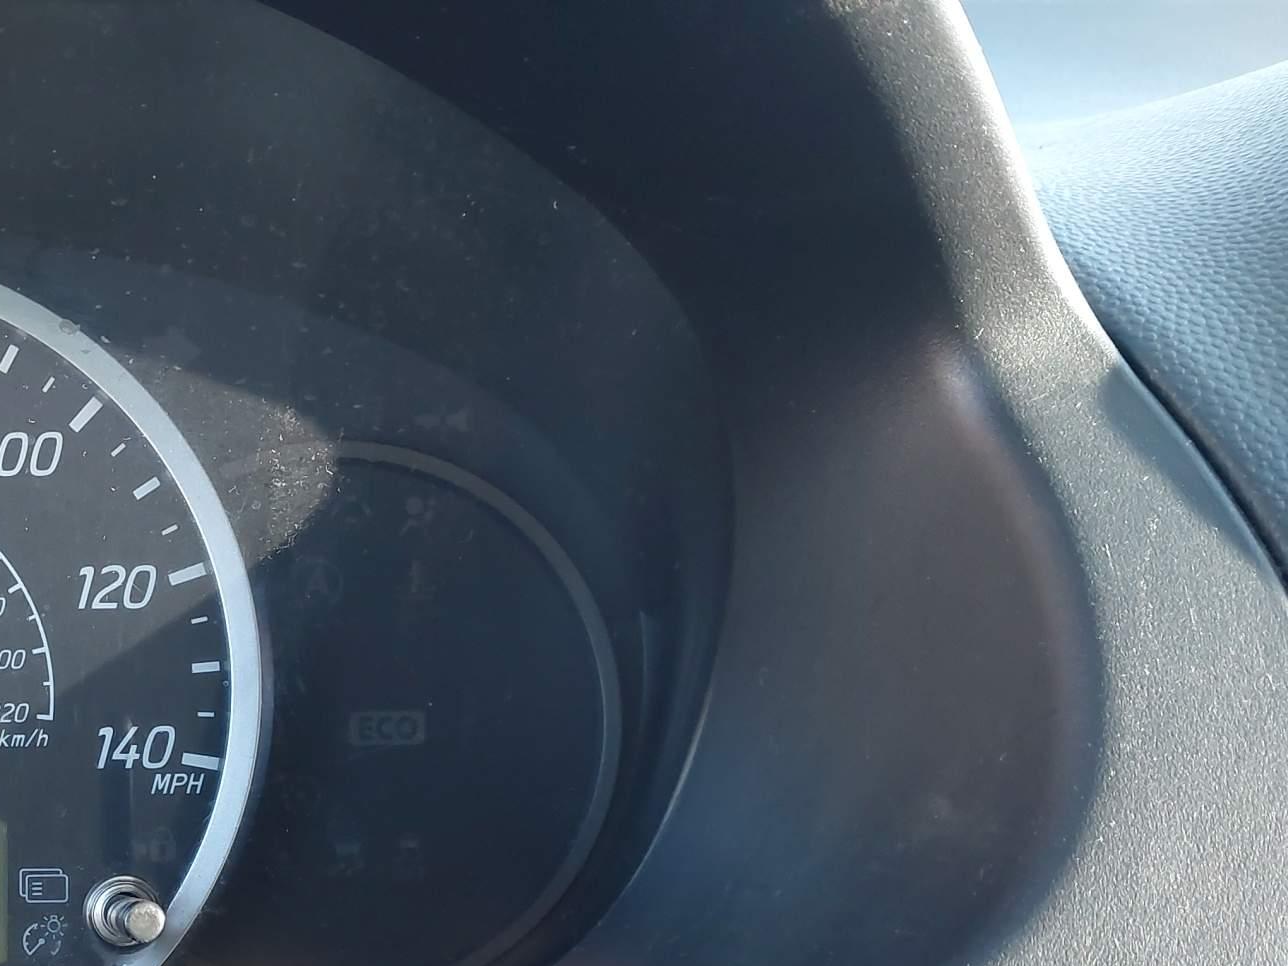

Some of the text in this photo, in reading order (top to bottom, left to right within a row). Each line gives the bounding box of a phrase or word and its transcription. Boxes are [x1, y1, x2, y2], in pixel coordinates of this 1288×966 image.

[79, 565, 156, 609] 120
[0, 729, 48, 748] km/h
[359, 714, 418, 740] ECO
[98, 726, 175, 770] 140
[152, 774, 204, 796] MPH
